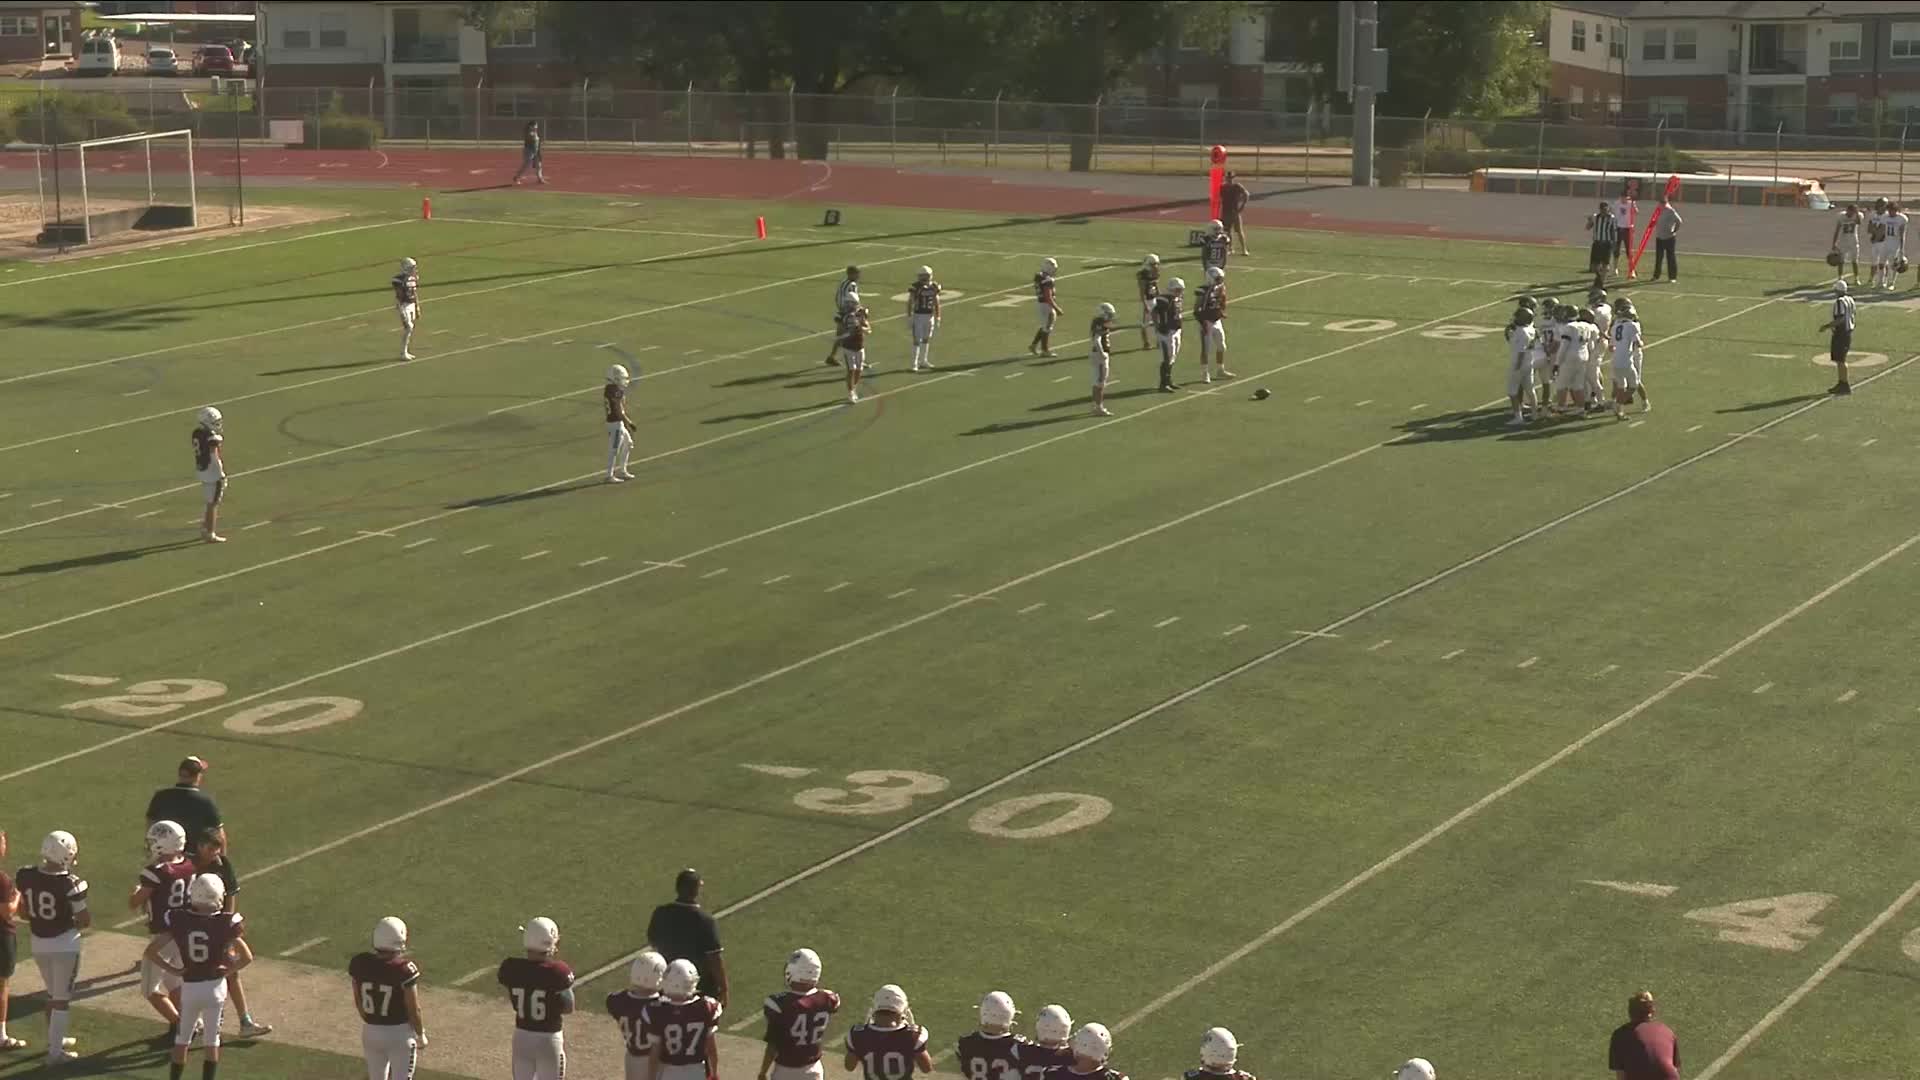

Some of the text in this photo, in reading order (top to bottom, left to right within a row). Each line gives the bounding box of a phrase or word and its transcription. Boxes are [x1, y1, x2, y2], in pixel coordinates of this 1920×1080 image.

[1615, 324, 1624, 341] 8
[60, 678, 365, 734] 20
[793, 768, 1113, 839] 30
[24, 887, 57, 920] 18
[167, 873, 193, 908] 8
[187, 930, 210, 963] 6
[360, 982, 393, 1017] 67
[511, 988, 547, 1021] 76
[664, 1022, 705, 1056] 87
[790, 1012, 830, 1046] 42
[863, 1051, 906, 1080] 10
